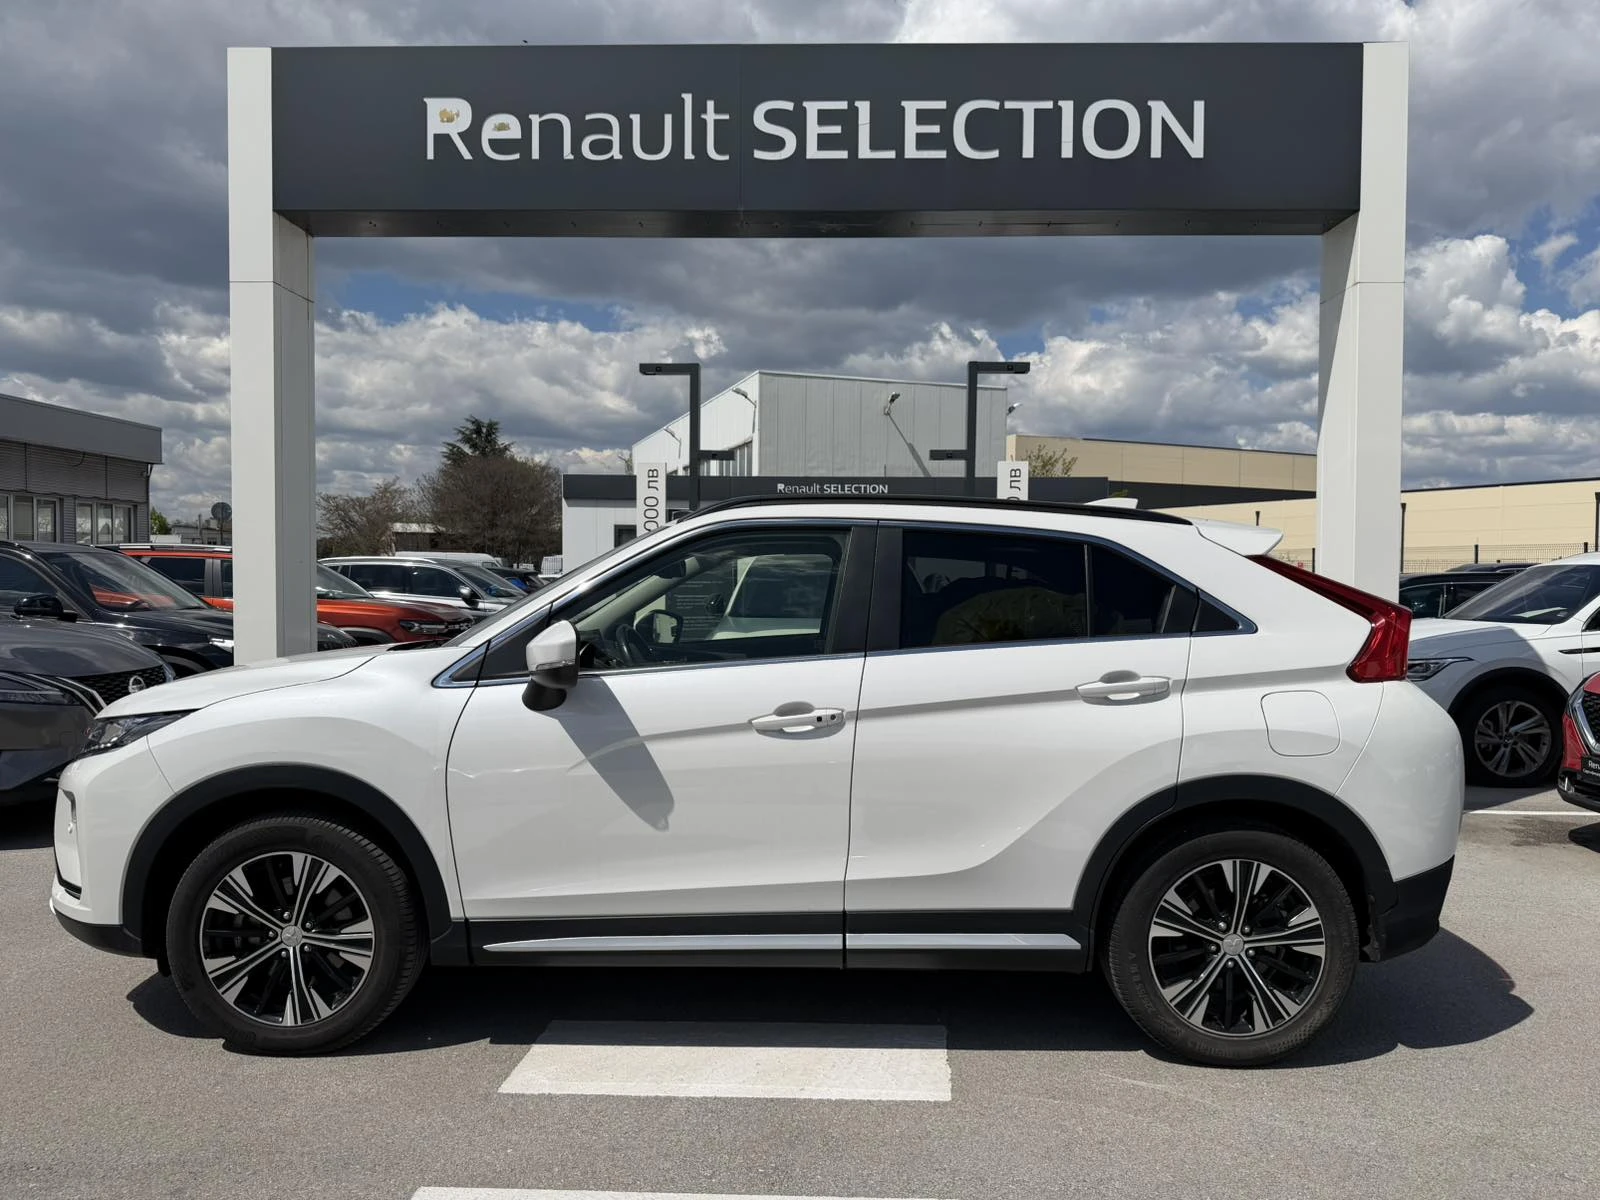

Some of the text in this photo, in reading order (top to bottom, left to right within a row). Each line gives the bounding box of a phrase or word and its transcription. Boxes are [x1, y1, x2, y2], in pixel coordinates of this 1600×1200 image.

[423, 93, 1205, 161] Renault SELECTION
[776, 482, 888, 495] Renault SELECTION
